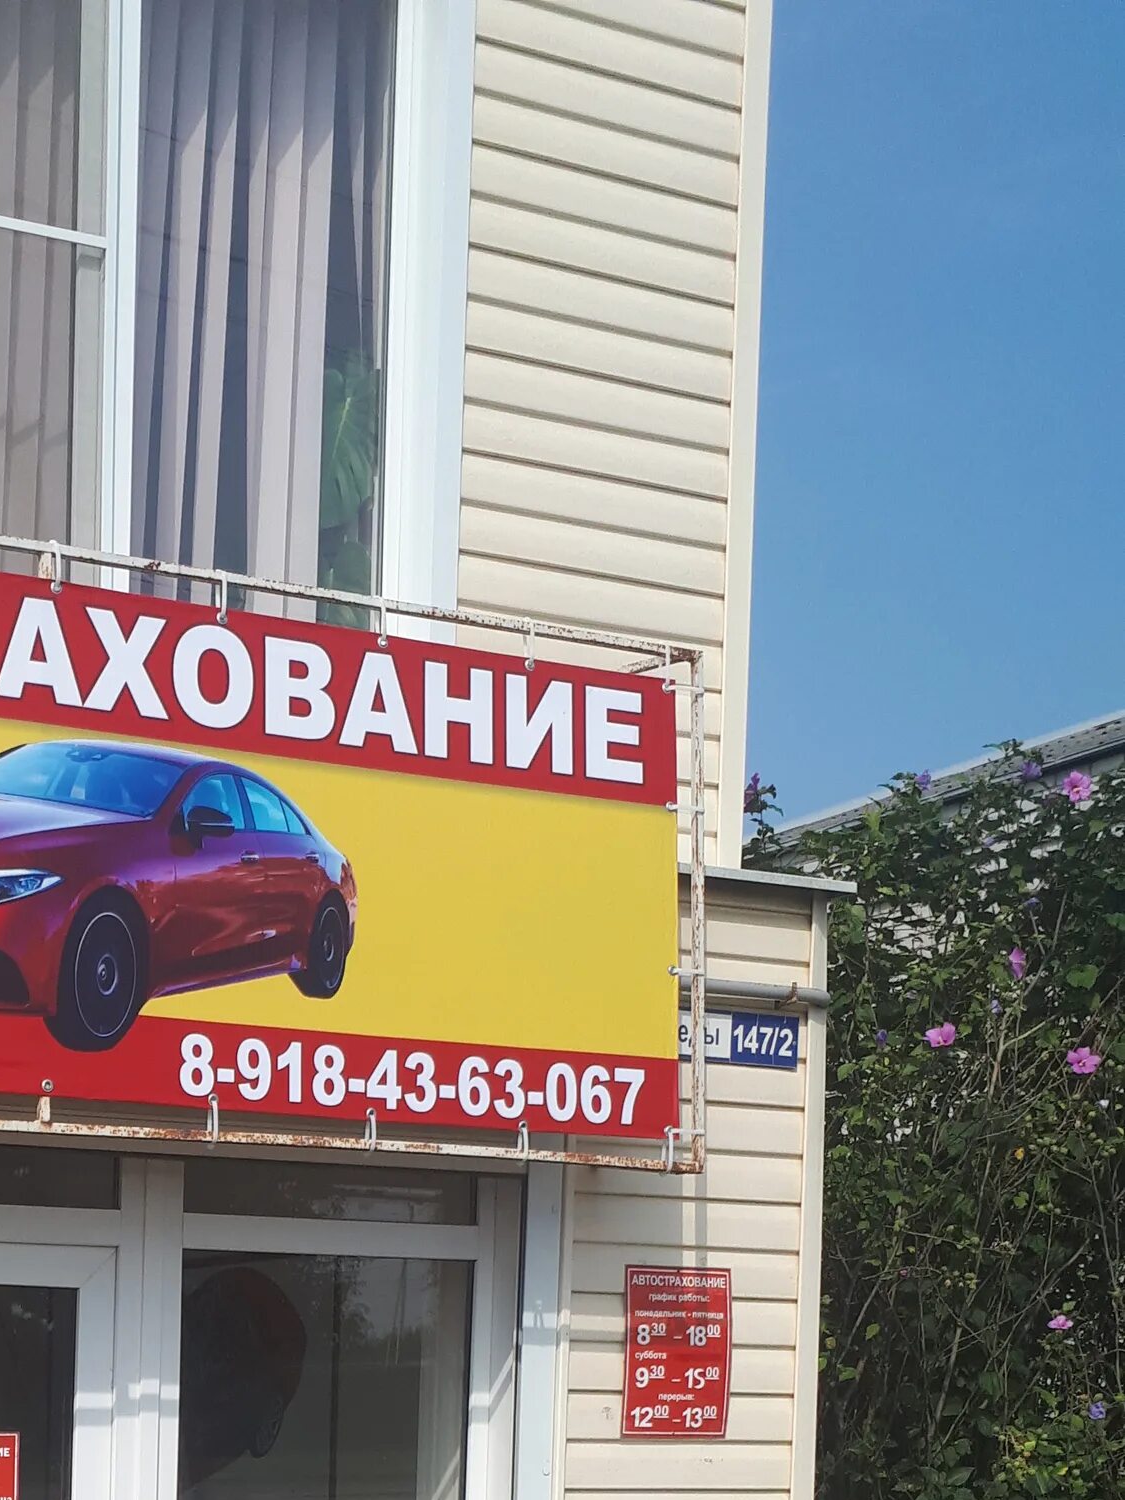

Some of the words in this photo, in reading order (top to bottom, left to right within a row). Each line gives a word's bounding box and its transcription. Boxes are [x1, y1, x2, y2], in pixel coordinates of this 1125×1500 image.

[733, 1024, 793, 1057] 147/2
[179, 1033, 645, 1126] 8-918-43-63-067
[631, 1274, 726, 1288] АВТОСТРАХОВАНИЕ
